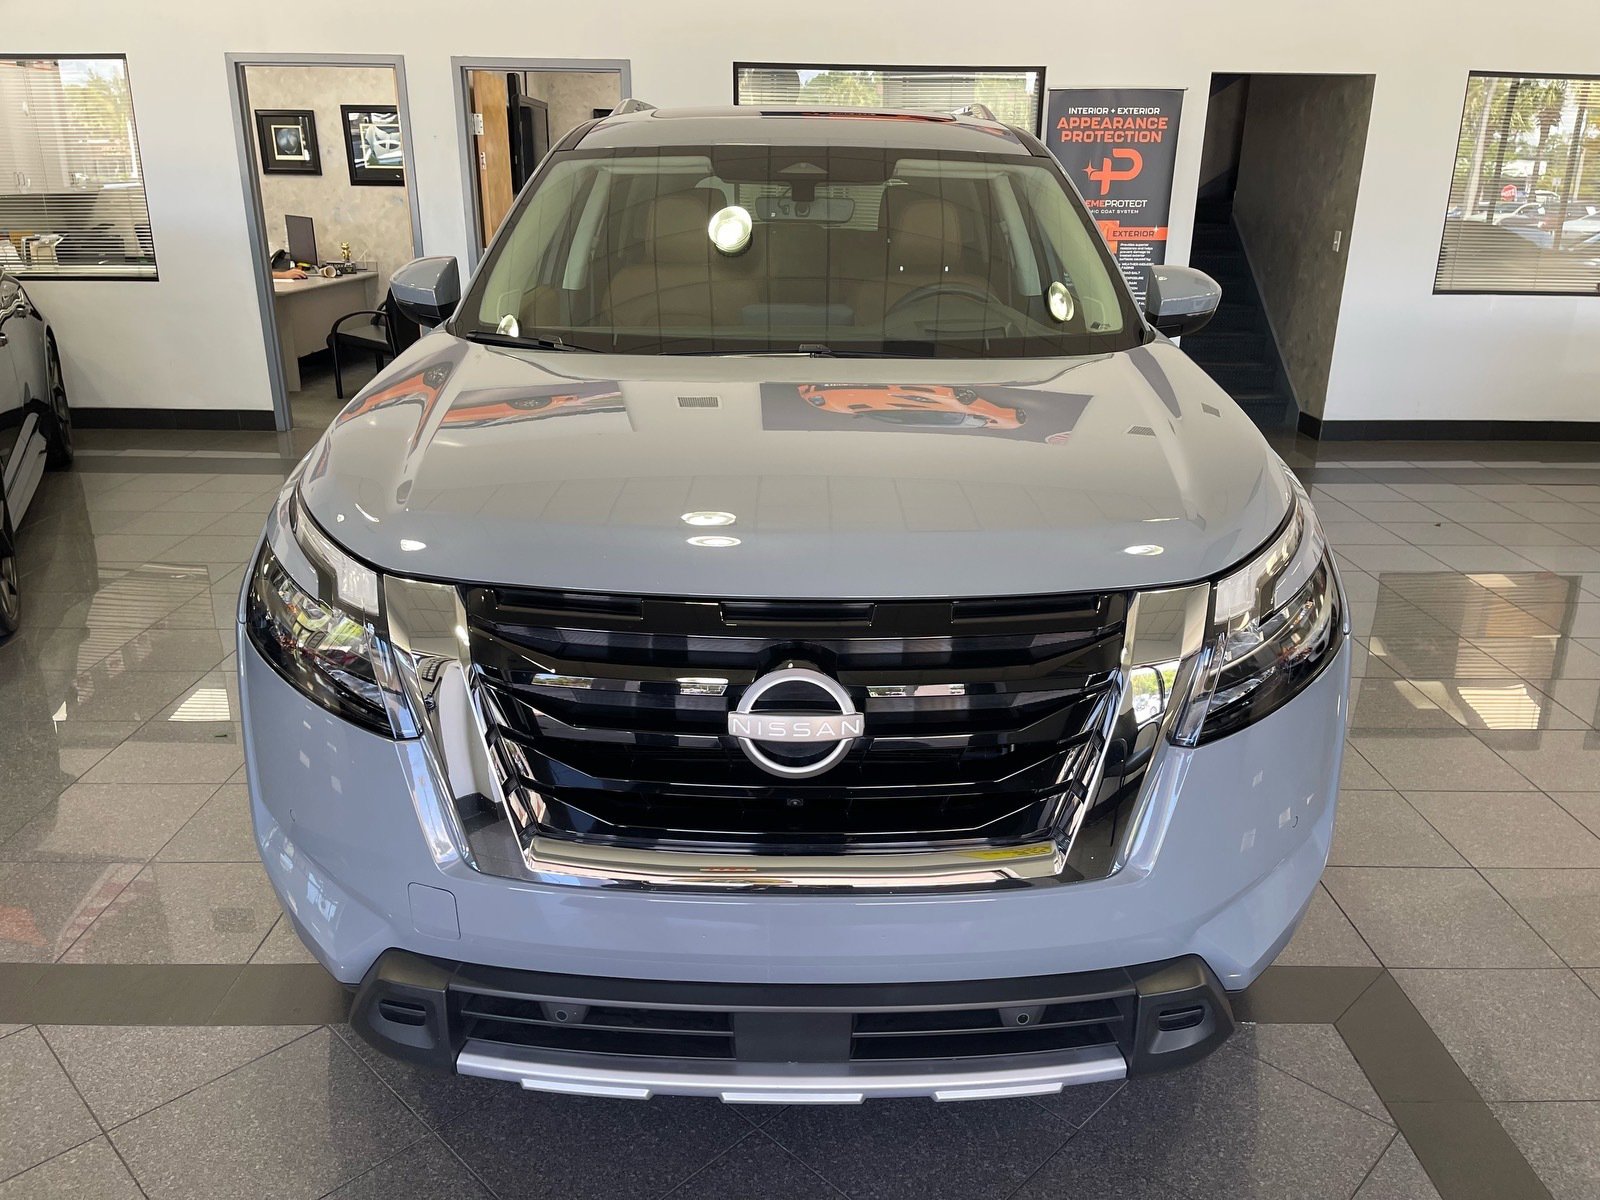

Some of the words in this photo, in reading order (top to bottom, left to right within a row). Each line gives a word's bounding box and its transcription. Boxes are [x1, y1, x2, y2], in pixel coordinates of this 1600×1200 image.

[1068, 107, 1109, 115] INTERIOR
[1117, 107, 1160, 115] EXTERIOR
[1057, 117, 1168, 129] APPEARANCE
[1061, 131, 1162, 143] PROTECTION
[1085, 199, 1148, 208] EMEPROTECT
[732, 719, 860, 737] NISSAN
